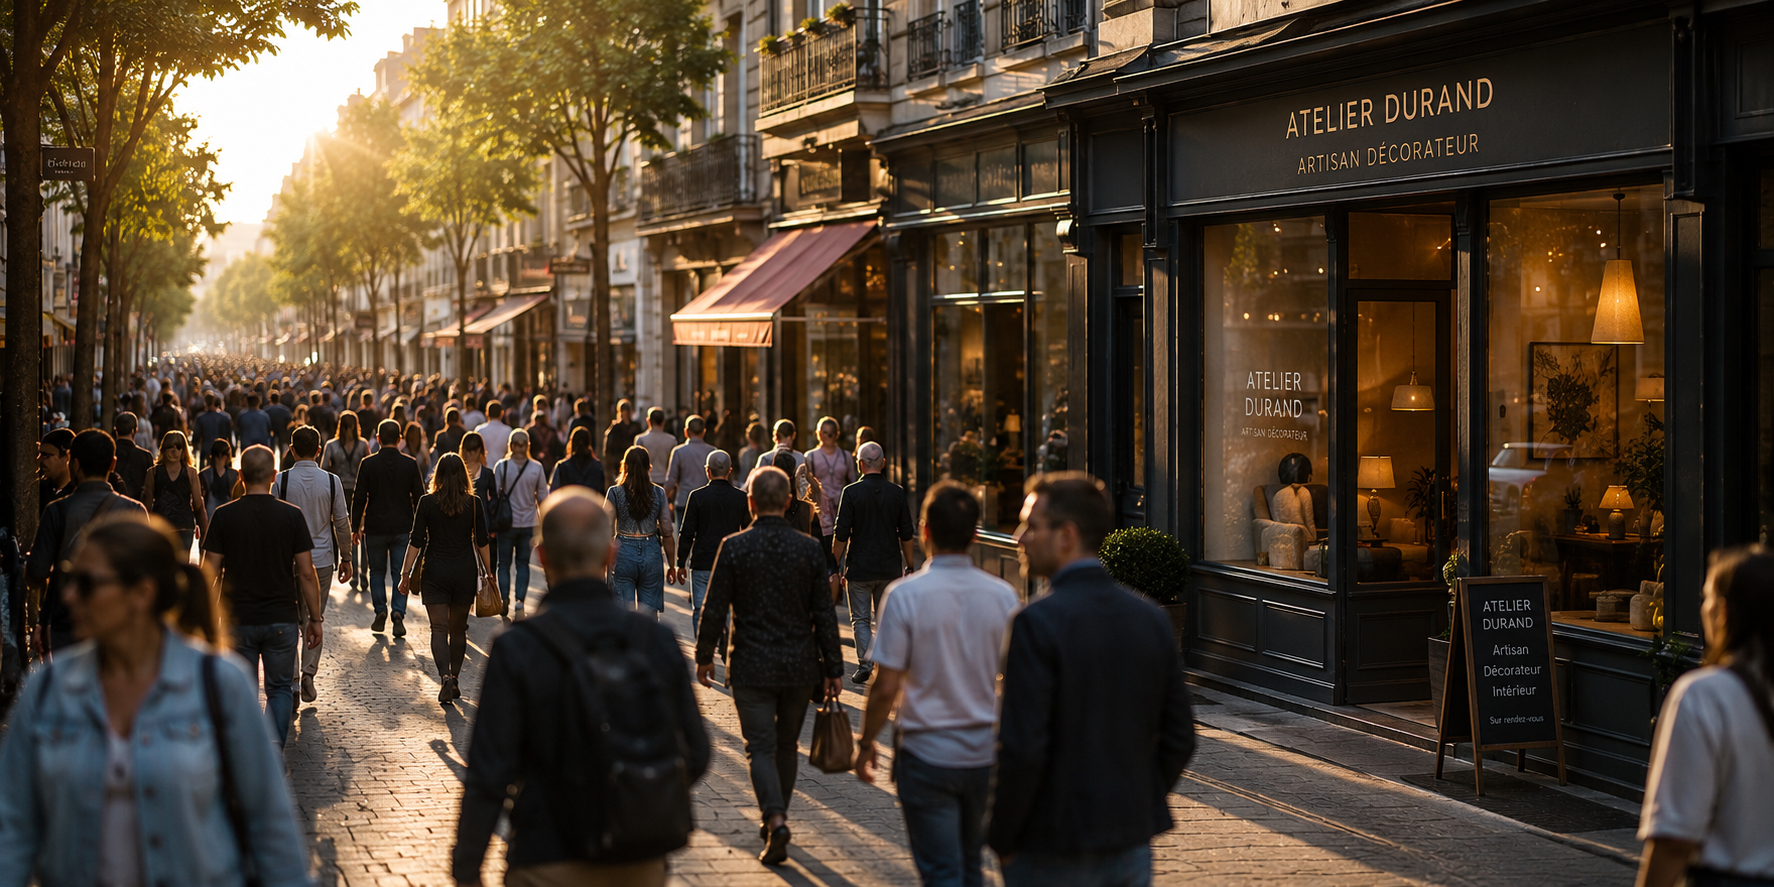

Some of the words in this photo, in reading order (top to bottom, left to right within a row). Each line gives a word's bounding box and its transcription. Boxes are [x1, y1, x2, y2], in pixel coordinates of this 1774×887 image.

[1285, 98, 1374, 139] ATELIER
[1385, 77, 1494, 124] DURAND
[1297, 149, 1360, 175] ARTISAN
[1367, 133, 1479, 166] DÉCORATEUR
[1246, 371, 1302, 391] ATELIER
[1245, 397, 1303, 418] DURAND
[1482, 599, 1532, 612] ATELIER
[1482, 617, 1534, 630] DURAND
[1492, 644, 1529, 656] Artisan
[1483, 664, 1541, 677] Décorateur
[1492, 684, 1537, 697] Intérieur
[1489, 716, 1502, 725] Sur
[1503, 714, 1544, 724] rendez-vous
